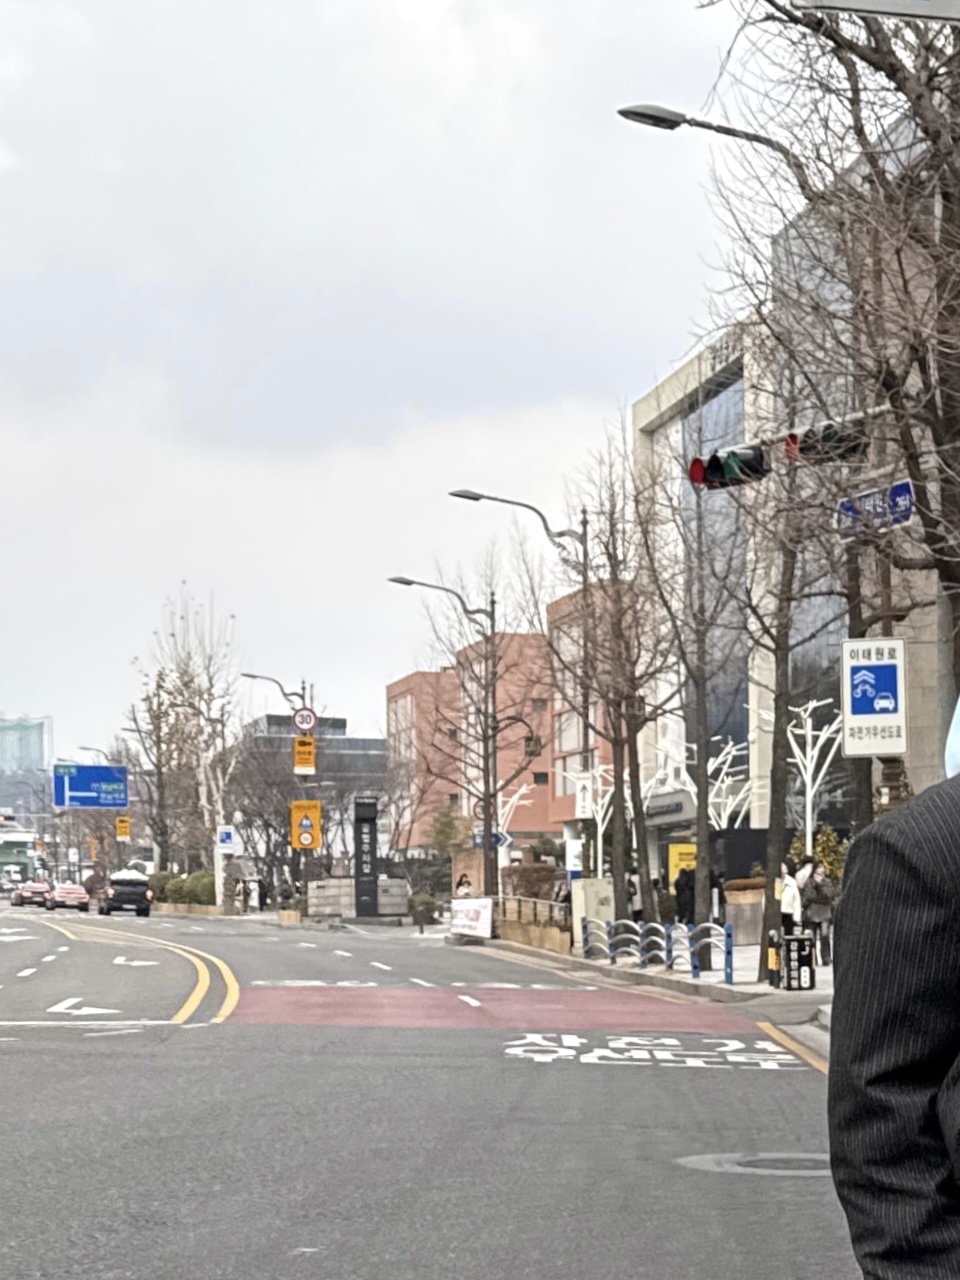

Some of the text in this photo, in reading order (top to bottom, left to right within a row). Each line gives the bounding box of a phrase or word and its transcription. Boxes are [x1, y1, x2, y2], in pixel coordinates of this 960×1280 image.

[849, 648, 897, 661] 이태원로
[298, 714, 312, 725] 30
[848, 725, 902, 740] 자전거우선도로
[502, 1033, 789, 1052] 자전거
